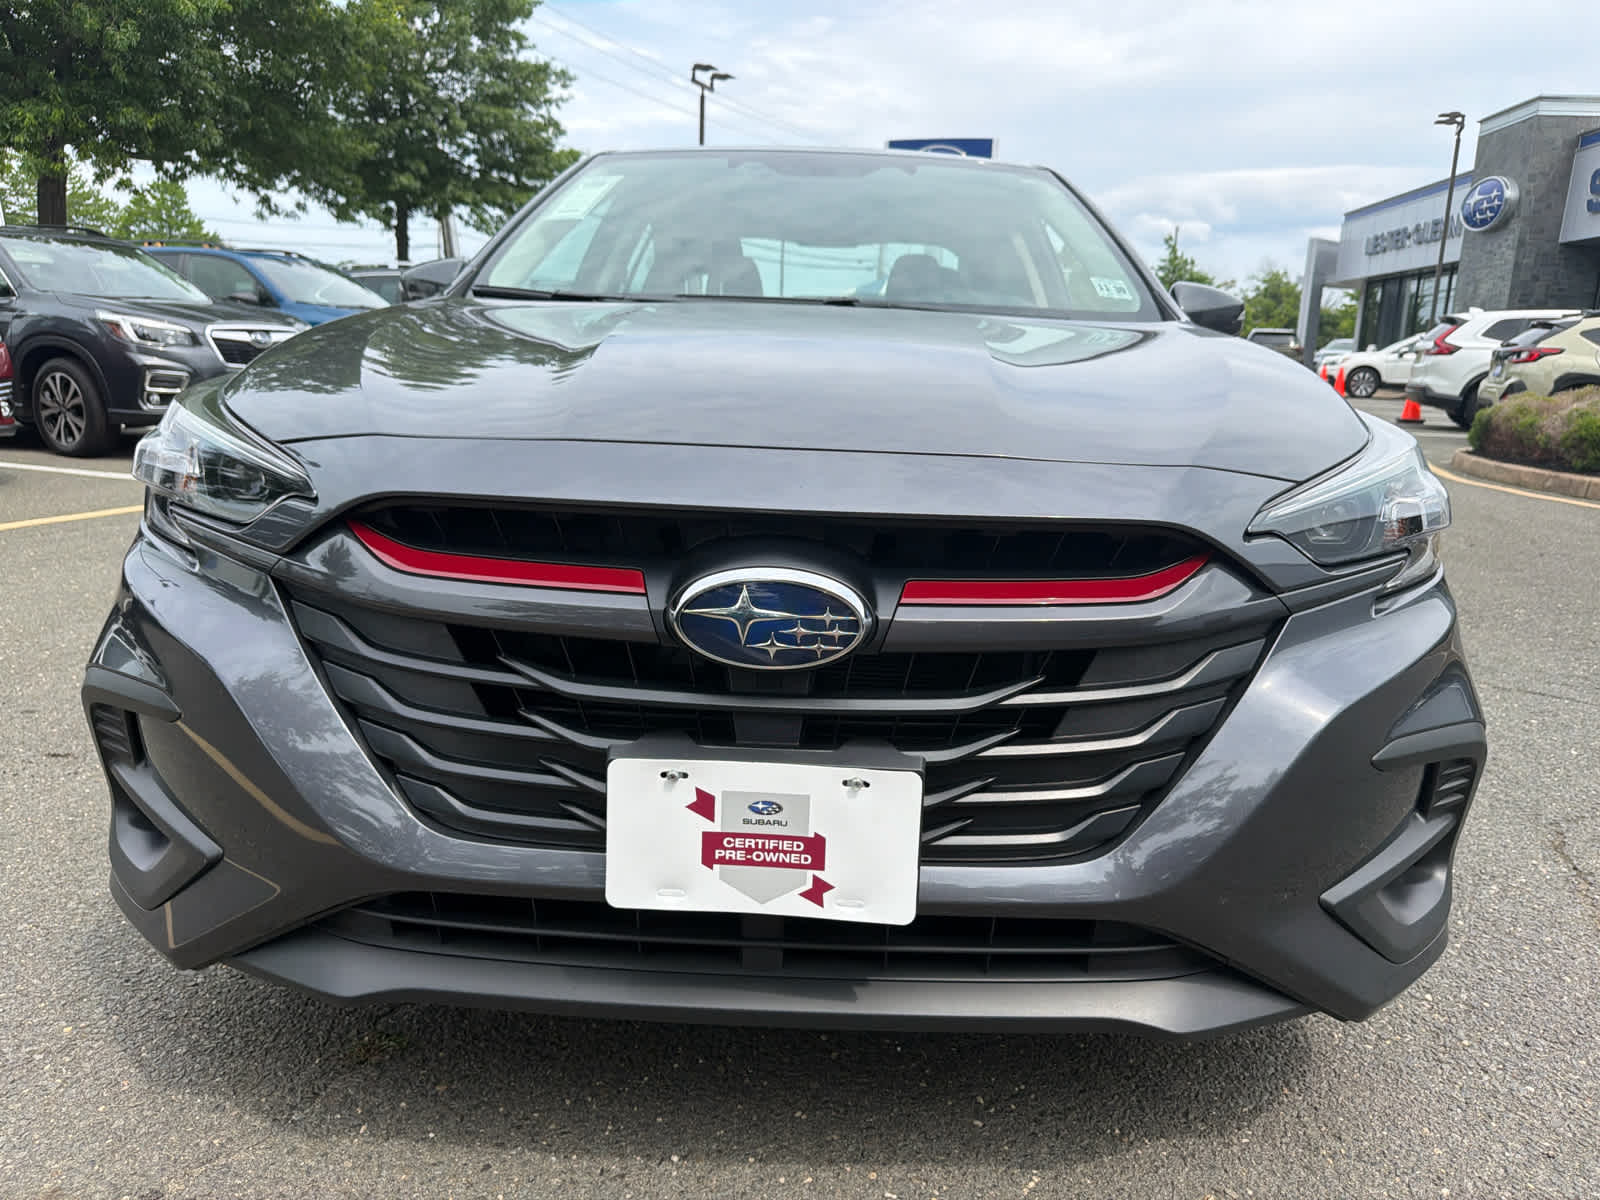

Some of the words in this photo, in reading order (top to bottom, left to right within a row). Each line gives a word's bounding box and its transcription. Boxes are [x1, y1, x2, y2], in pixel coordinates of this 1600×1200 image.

[1412, 214, 1462, 244] GLEN
[742, 818, 787, 827] SUBARU
[723, 838, 804, 851] CERTIFIED
[715, 850, 812, 864] PRE-OWNED
